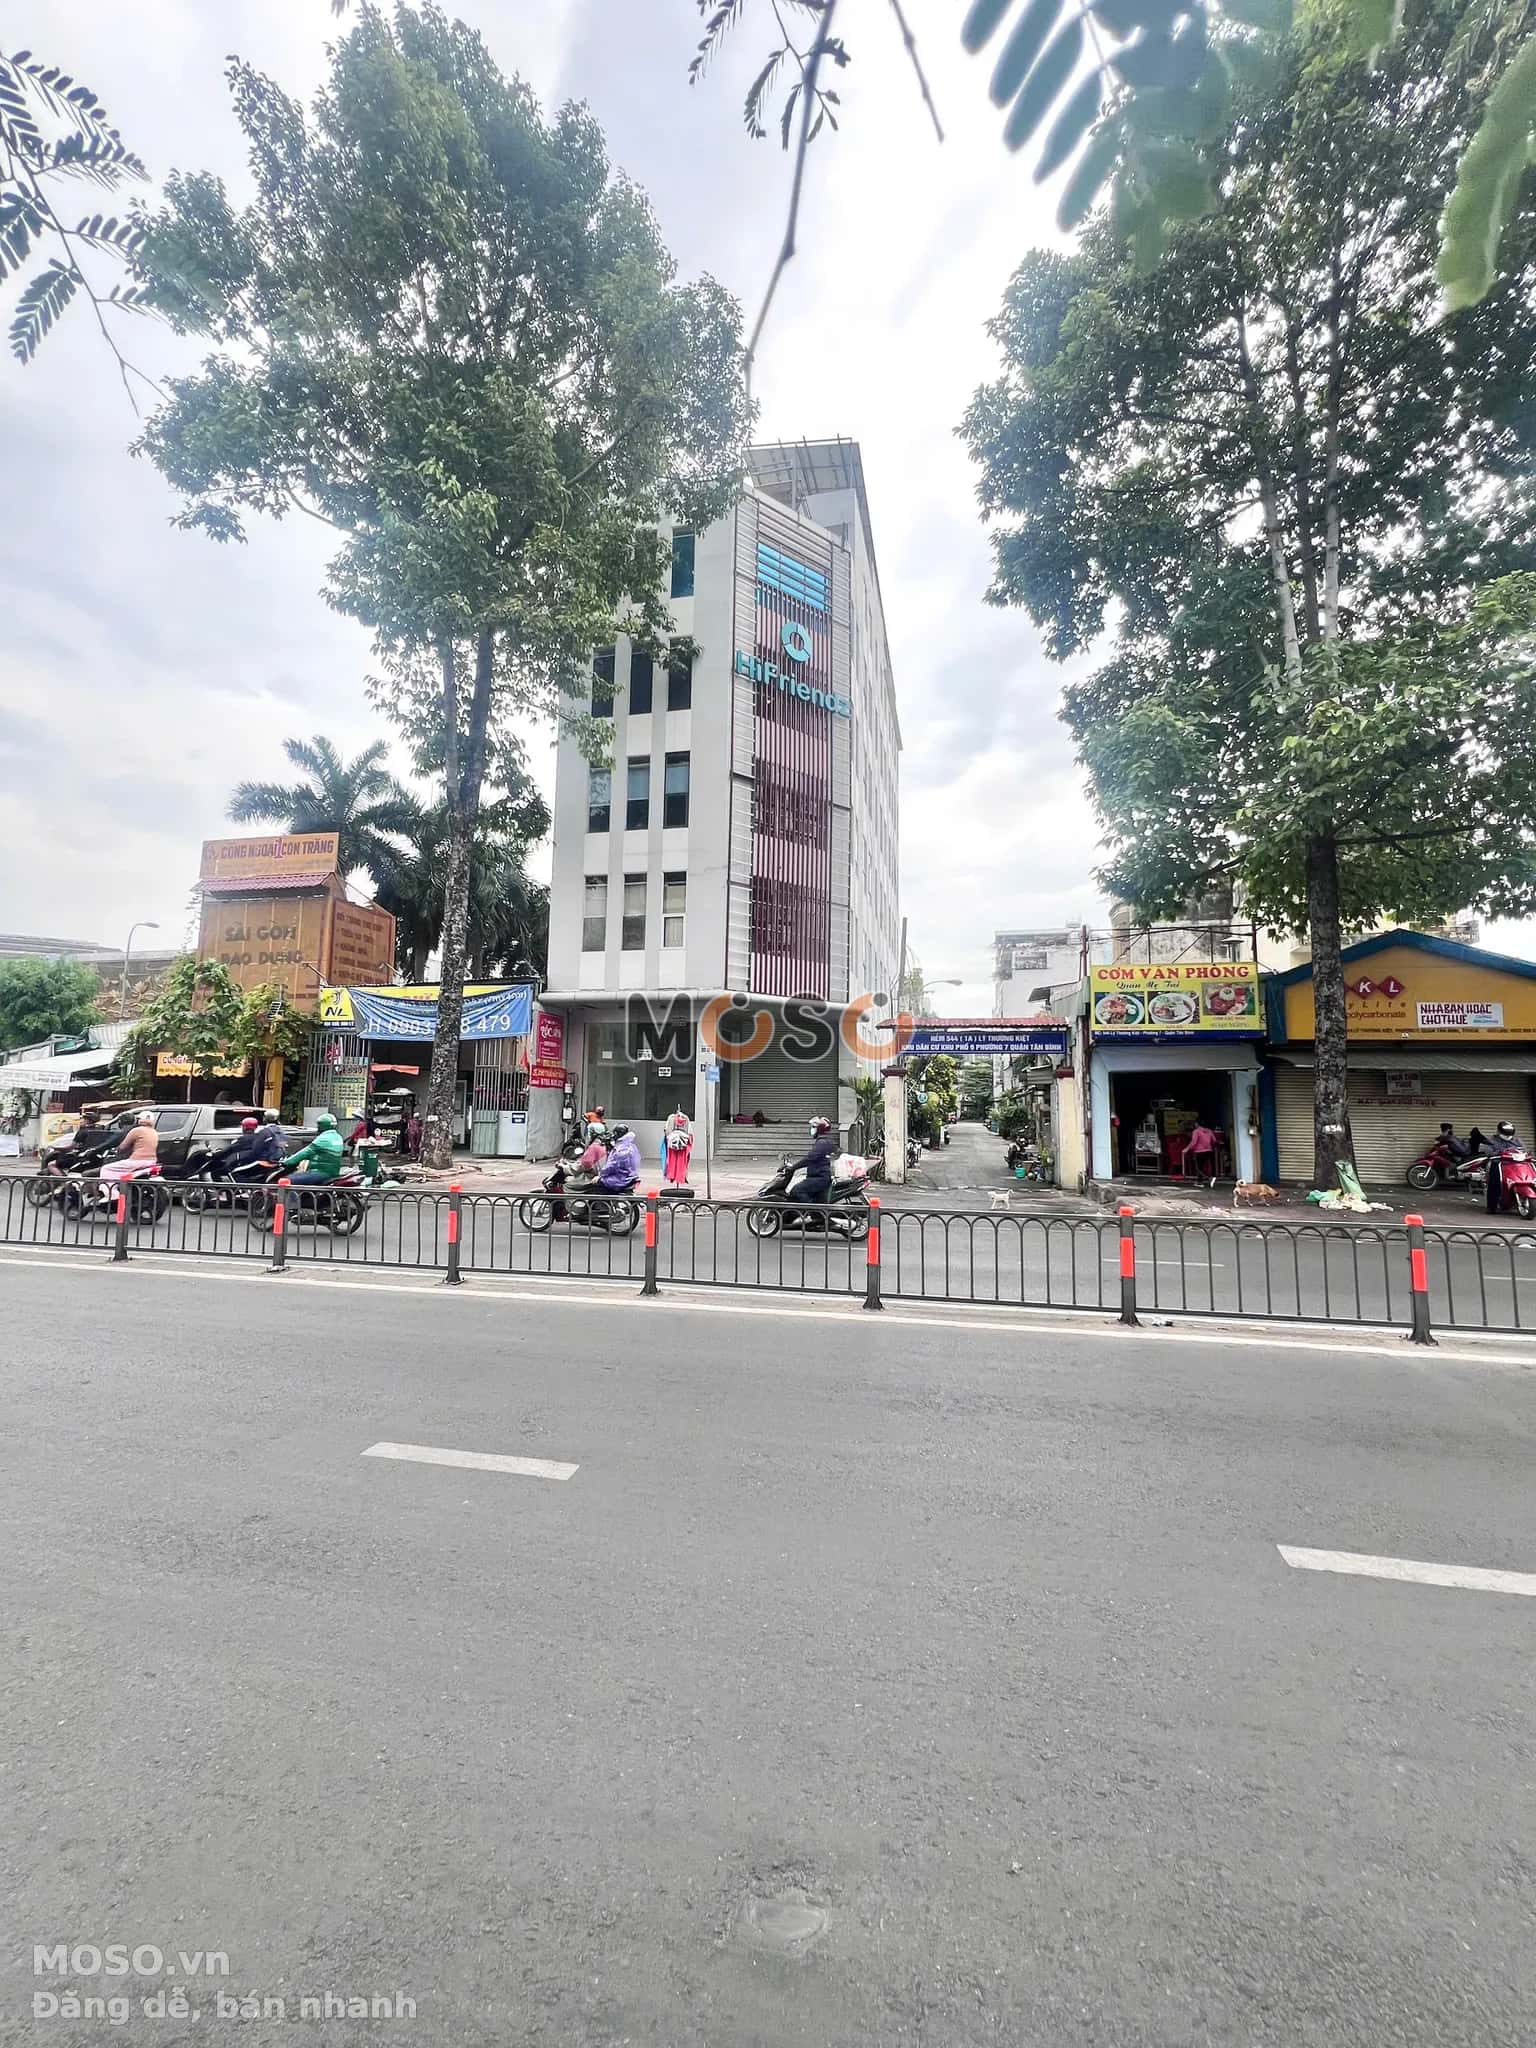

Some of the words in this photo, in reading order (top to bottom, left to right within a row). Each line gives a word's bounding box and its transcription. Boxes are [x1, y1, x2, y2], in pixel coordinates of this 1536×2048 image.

[1098, 967, 1134, 980] CƠM
[1140, 965, 1179, 979] VĂN
[1185, 963, 1249, 979] PHÒNG
